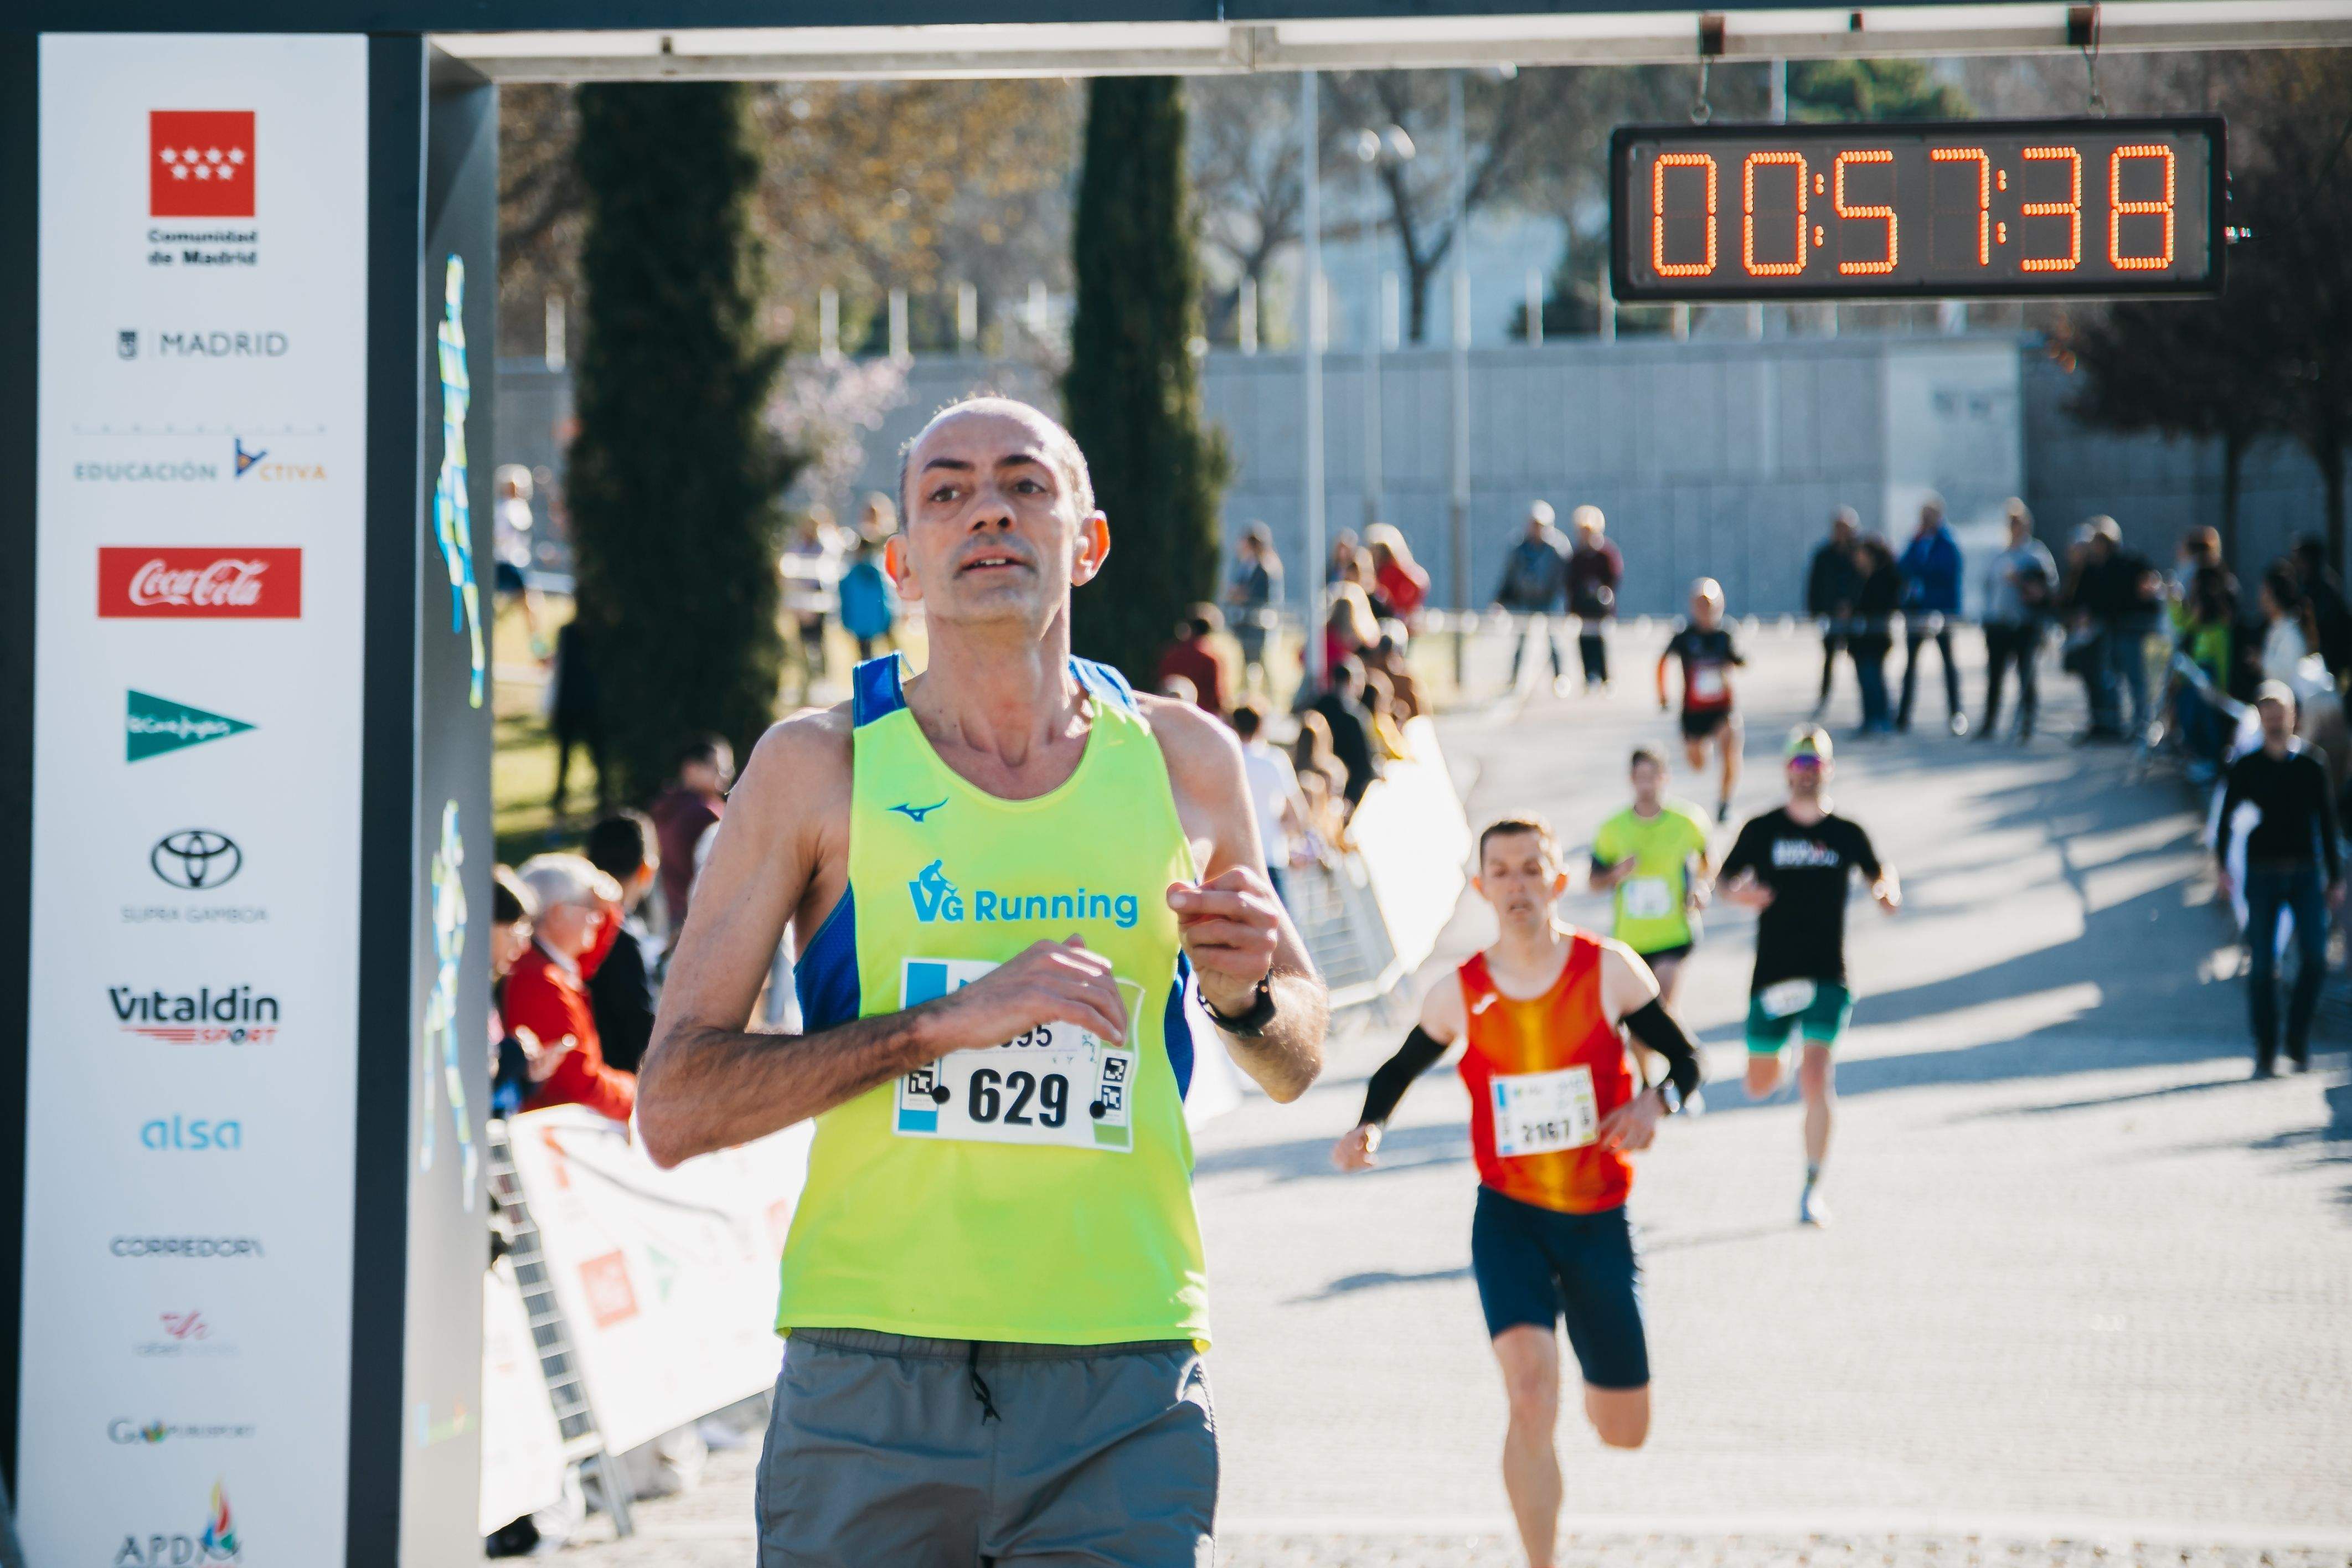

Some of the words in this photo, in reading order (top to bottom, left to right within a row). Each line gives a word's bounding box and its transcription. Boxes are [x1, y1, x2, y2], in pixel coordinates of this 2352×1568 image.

[1654, 145, 2175, 276] 00:57:38
[148, 229, 258, 243] Comunidad
[148, 250, 173, 265] de
[183, 249, 258, 265] Madrid
[160, 332, 288, 357] MADRID
[74, 461, 218, 481] EDUCACIÓN
[974, 888, 1138, 928] Running
[109, 985, 279, 1023] Vitaldin
[199, 1028, 276, 1045] SPORT
[1000, 1023, 1053, 1048] 95
[968, 1068, 1069, 1129] 629
[141, 1115, 242, 1150] alsa
